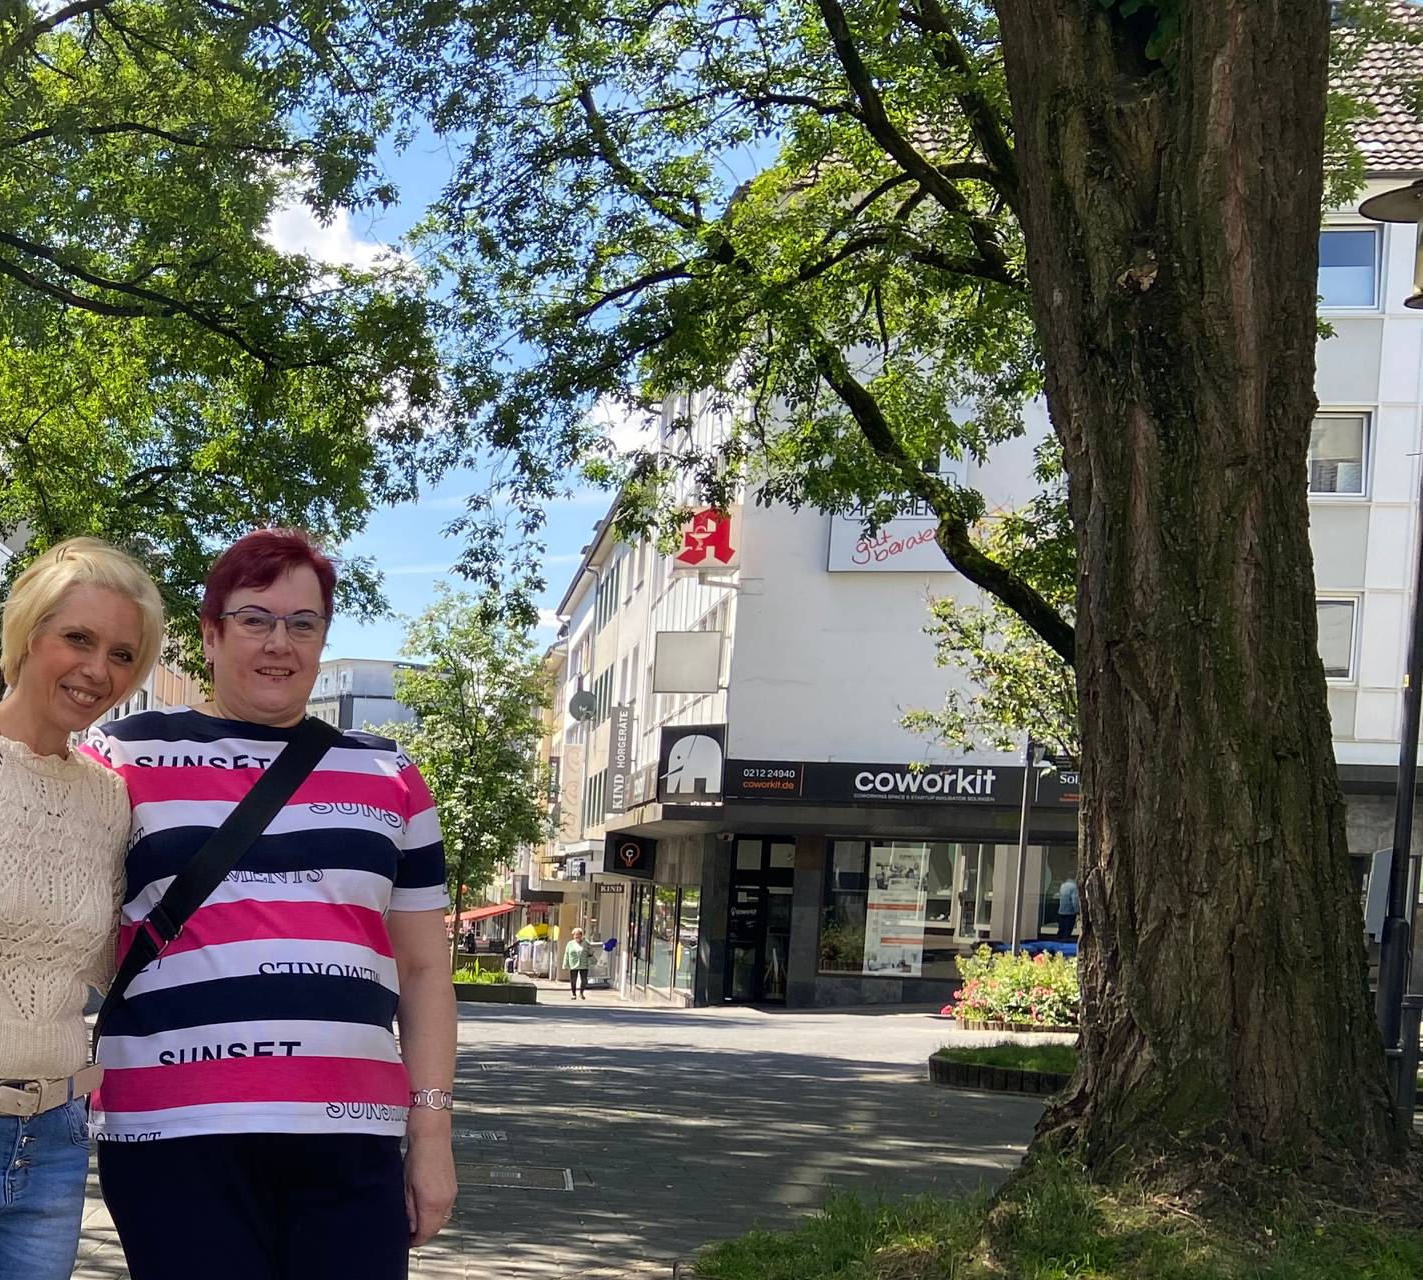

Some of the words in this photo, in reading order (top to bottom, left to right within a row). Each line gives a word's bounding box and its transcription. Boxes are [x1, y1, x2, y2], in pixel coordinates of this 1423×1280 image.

[852, 530, 892, 565] gut
[875, 527, 939, 562] berate
[615, 710, 628, 768] HÖRGERÄTE
[743, 769, 766, 777] 0212
[767, 769, 795, 778] 24940
[743, 780, 794, 790] coworkit.de
[854, 767, 996, 794] coworkit
[1059, 774, 1081, 785] Sol
[612, 774, 625, 810] KIND
[159, 1041, 301, 1066] SUNSET
